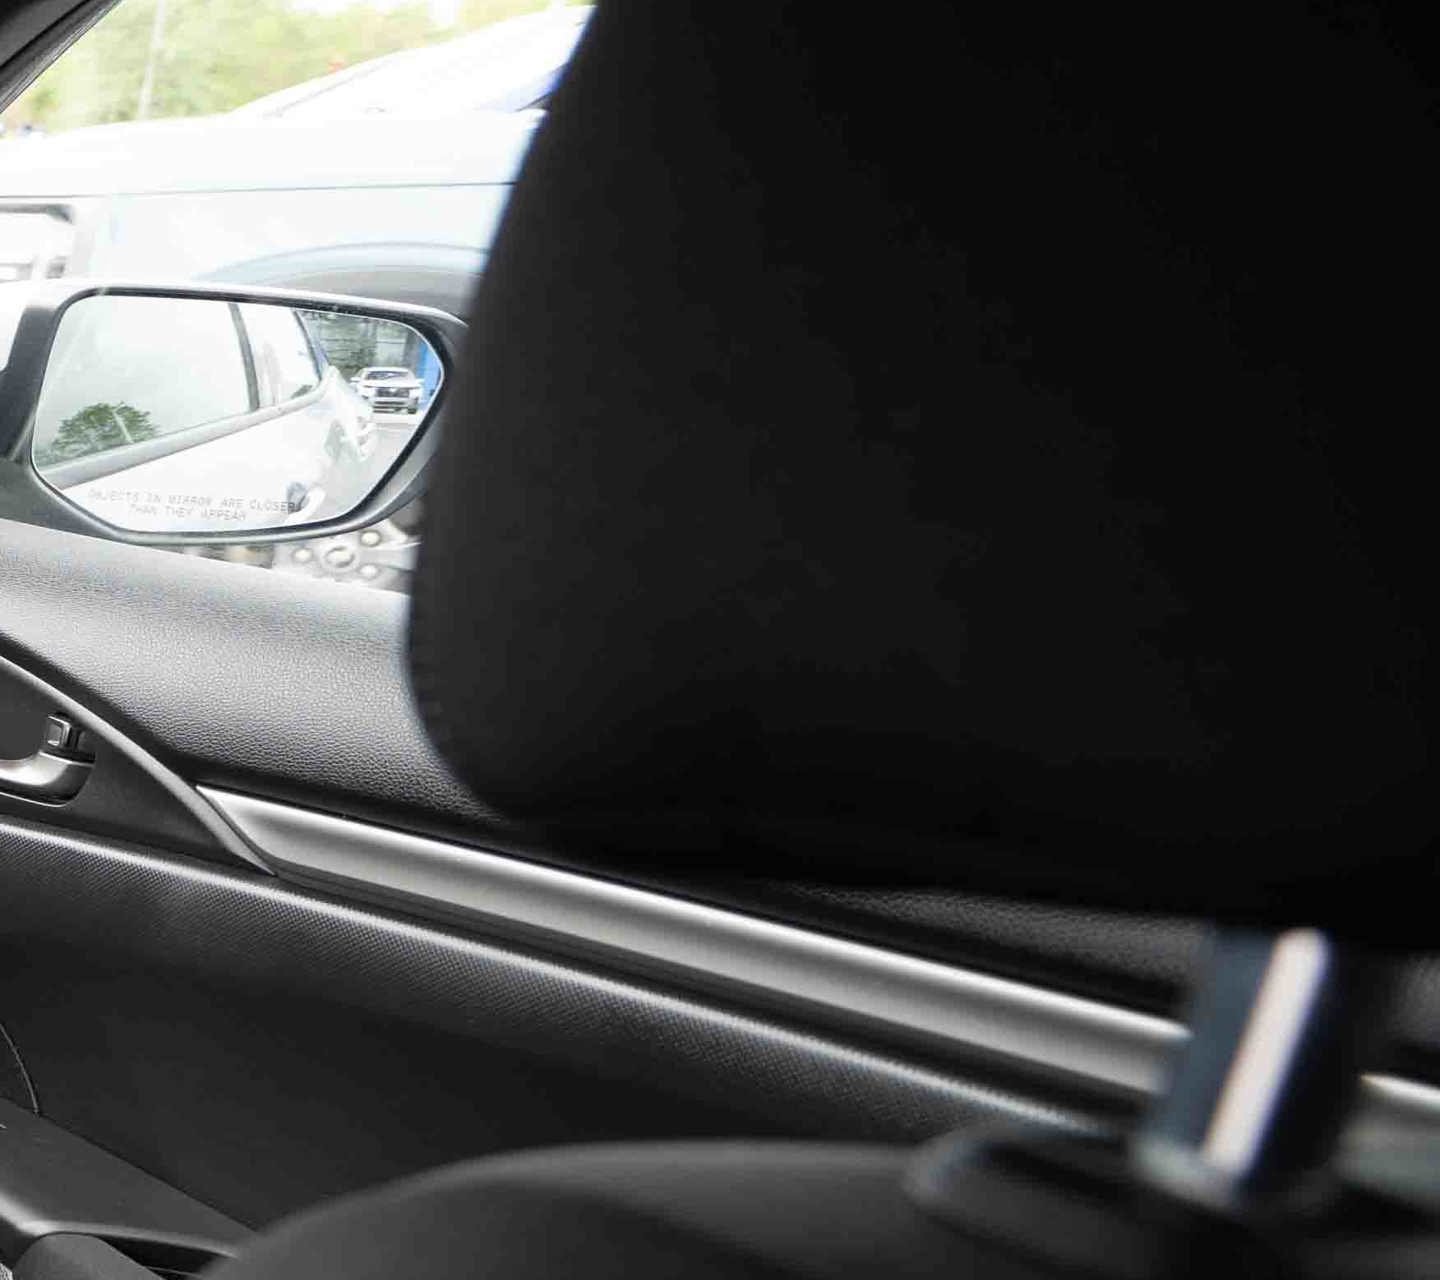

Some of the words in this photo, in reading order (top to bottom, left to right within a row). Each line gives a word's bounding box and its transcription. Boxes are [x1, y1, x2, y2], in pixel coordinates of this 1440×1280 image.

[145, 492, 161, 504] IN
[168, 494, 212, 507] MIRROR
[222, 497, 244, 509] ARE
[165, 506, 191, 518] THEY
